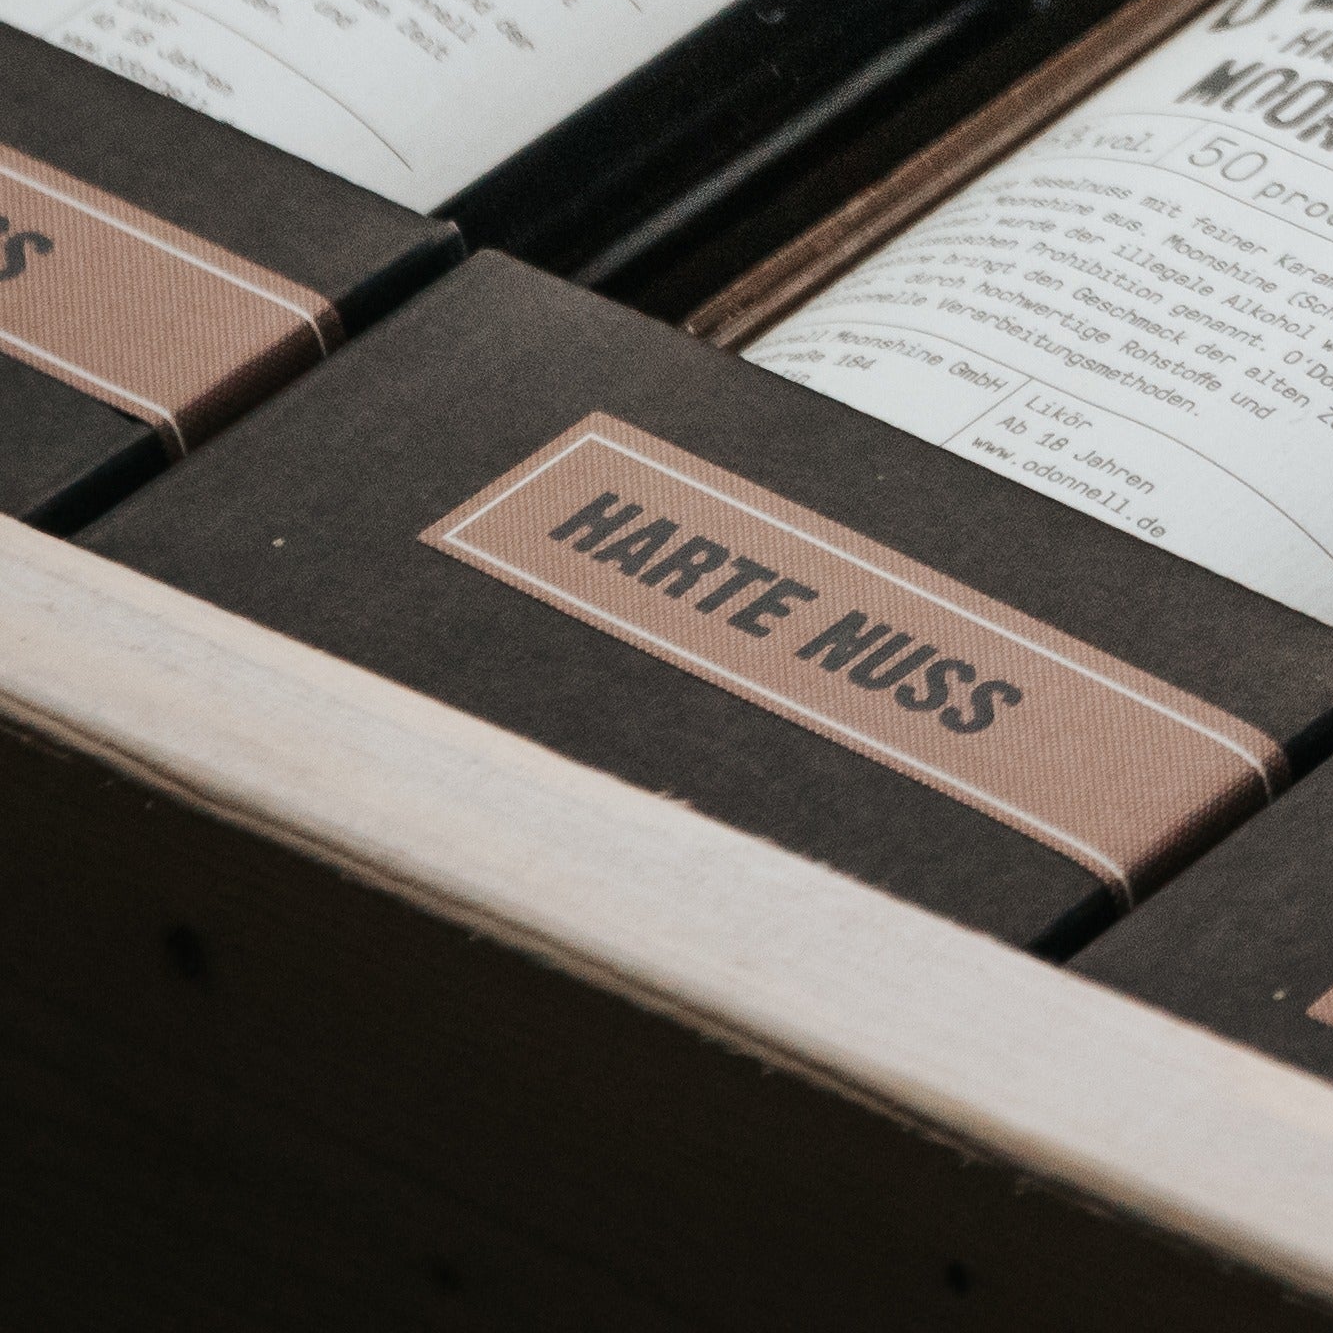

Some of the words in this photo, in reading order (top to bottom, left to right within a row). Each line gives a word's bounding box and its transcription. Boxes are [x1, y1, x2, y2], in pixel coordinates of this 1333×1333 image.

[1186, 133, 1271, 184] 50
[1100, 208, 1147, 238] aus.
[1159, 231, 1280, 295] Moonshine
[1137, 193, 1184, 221] mit
[1190, 214, 1270, 256] feiner
[1024, 238, 1166, 306] Prohibition
[1166, 302, 1267, 353] genannt.
[1063, 225, 1108, 246] der
[1110, 242, 1216, 298] illegale
[1219, 292, 1318, 341] Alkohol
[831, 353, 878, 372] 184
[835, 330, 944, 367] Moonshine
[947, 359, 1009, 394] GmbH
[903, 269, 968, 290] durch
[971, 278, 1114, 346] hochwertige
[1117, 337, 1224, 393] Rohstoffe
[1228, 390, 1279, 422] und
[935, 295, 1200, 418] Verarbeitungsmethoden.
[1021, 267, 1067, 293] den
[1069, 284, 1189, 347] Geschmack
[1192, 341, 1239, 366] der
[1242, 364, 1313, 410] alten
[994, 413, 1030, 437] Ab
[1033, 430, 1072, 453] 18
[1071, 448, 1158, 497] Jahren
[1023, 393, 1095, 431] Likör
[970, 434, 1169, 540] www.odonnell.de
[546, 489, 821, 641] HARTE
[793, 607, 1024, 738] NUSS
